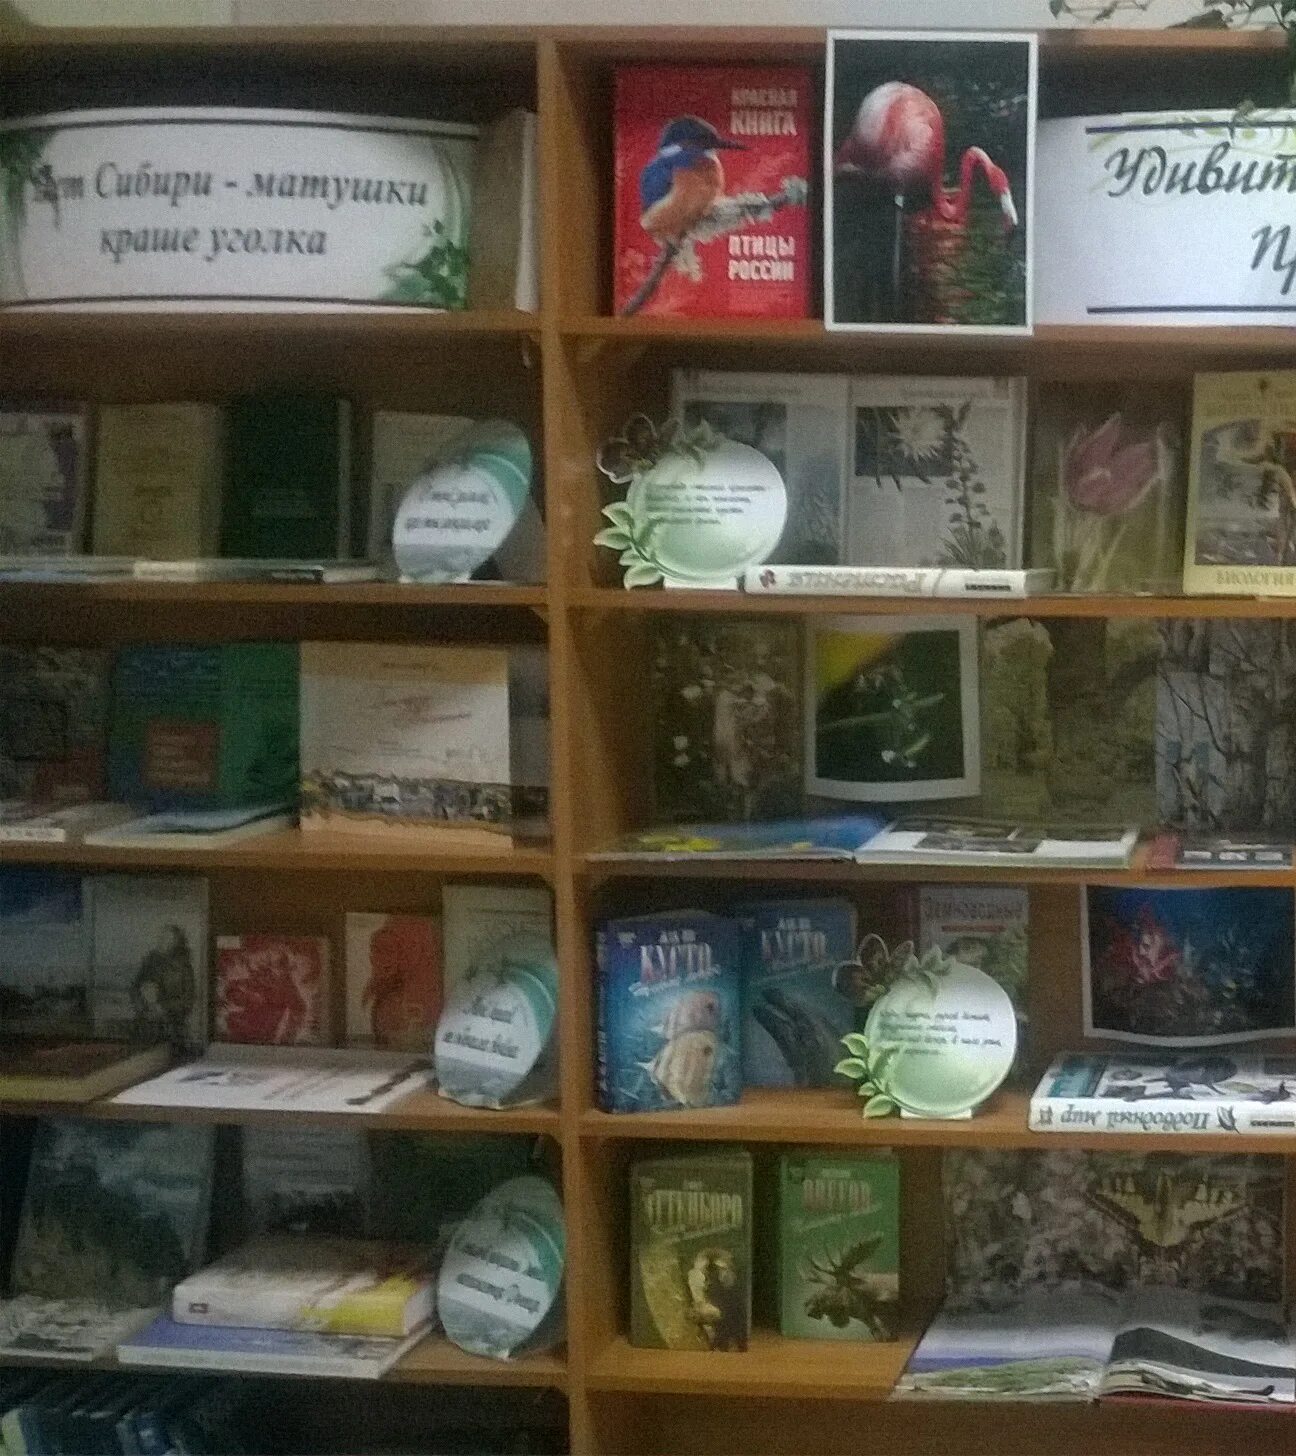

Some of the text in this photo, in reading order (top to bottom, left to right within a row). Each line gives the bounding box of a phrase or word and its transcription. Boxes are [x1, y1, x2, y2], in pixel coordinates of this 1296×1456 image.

[730, 110, 798, 136] КНИГА
[95, 162, 212, 206] Сибири
[246, 169, 428, 209] матушки
[100, 225, 328, 263] краше уголка
[728, 234, 796, 257] ПТИЦЫ
[728, 259, 795, 282] РОССИИ
[1060, 1109, 1211, 1131] Подводный мир
